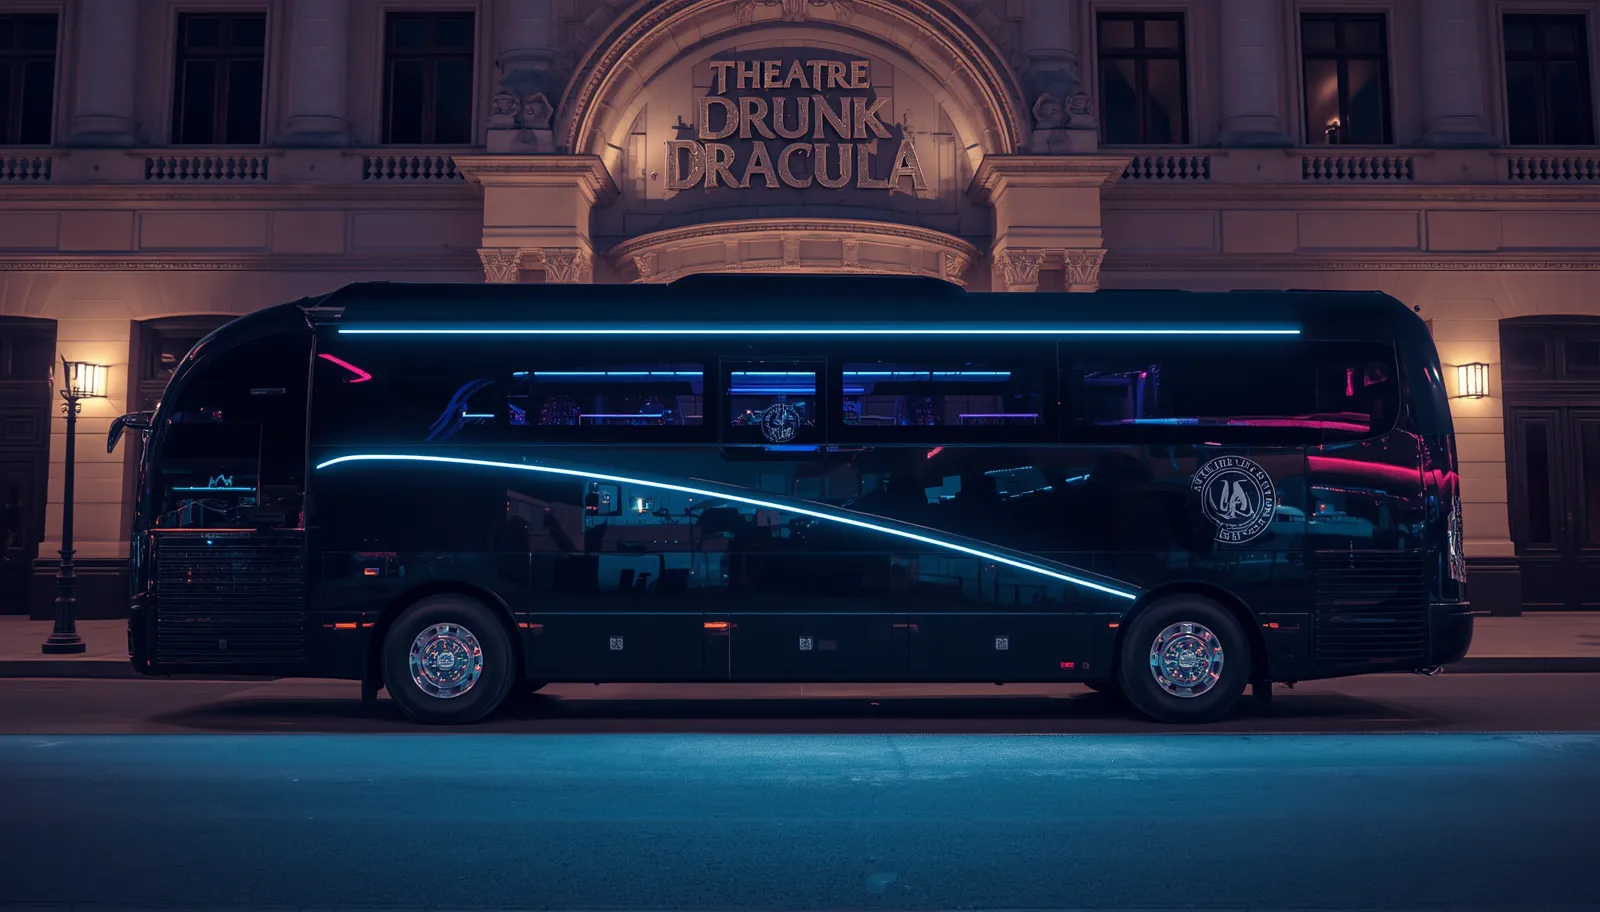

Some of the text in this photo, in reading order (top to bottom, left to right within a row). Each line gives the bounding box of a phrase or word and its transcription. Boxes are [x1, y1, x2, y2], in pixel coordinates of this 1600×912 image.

[709, 60, 870, 93] THEATRE
[699, 95, 892, 139] DRUNK
[664, 138, 928, 190] DRACULA
